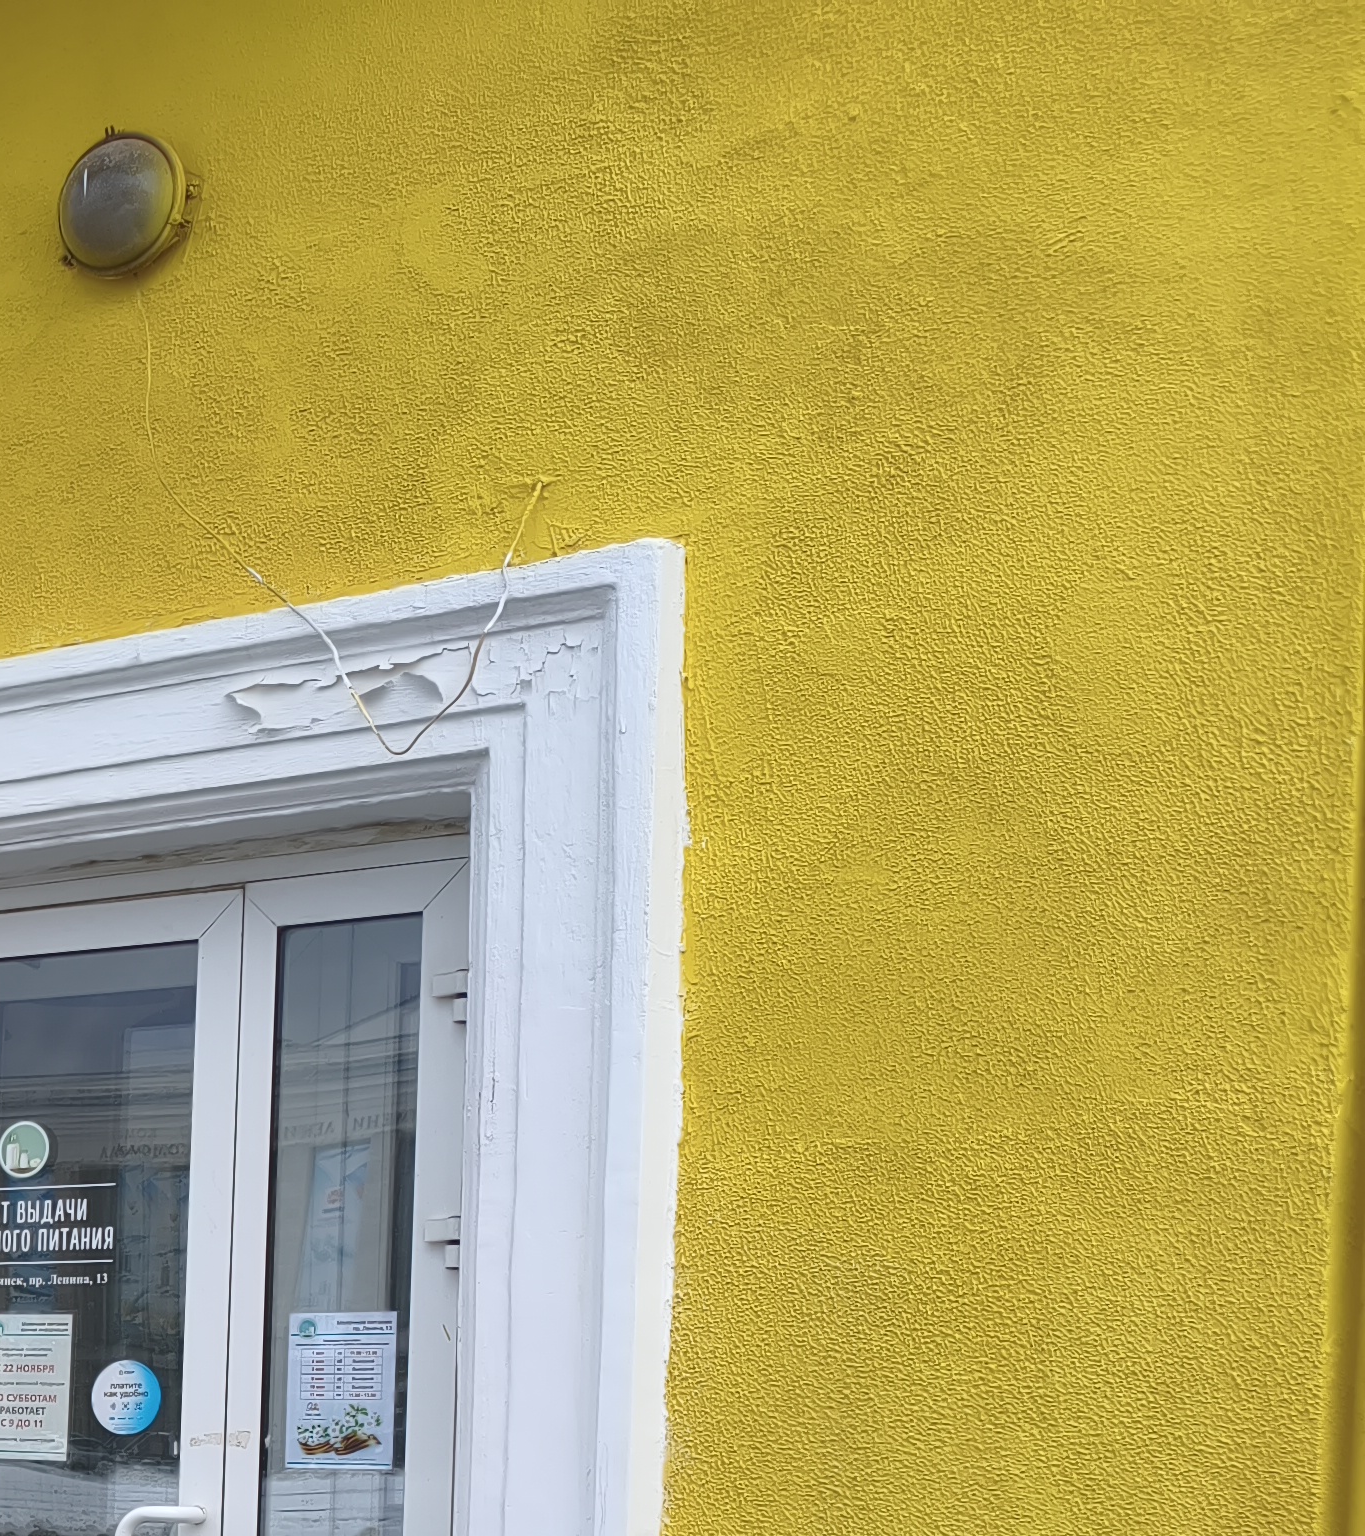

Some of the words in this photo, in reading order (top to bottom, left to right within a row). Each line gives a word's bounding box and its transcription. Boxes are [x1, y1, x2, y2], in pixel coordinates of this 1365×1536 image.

[16, 1198, 88, 1225] ВЫДАЧИ
[37, 1226, 114, 1251] ПИТАНИЯ
[29, 1277, 46, 1288] пр.
[48, 1274, 93, 1286] Ленина,
[96, 1273, 108, 1284] 13
[3, 1363, 14, 1373] 22
[16, 1364, 55, 1374] НОЯБРЯ
[110, 1382, 143, 1390] платите
[6, 1393, 57, 1404] СУББОТАМ
[119, 1388, 149, 1400] удобно
[0, 1406, 47, 1416] РАБОТАЕТ
[0, 1418, 7, 1428] С
[8, 1419, 15, 1428] 9
[16, 1419, 31, 1430] ДО
[33, 1419, 43, 1429] 11
